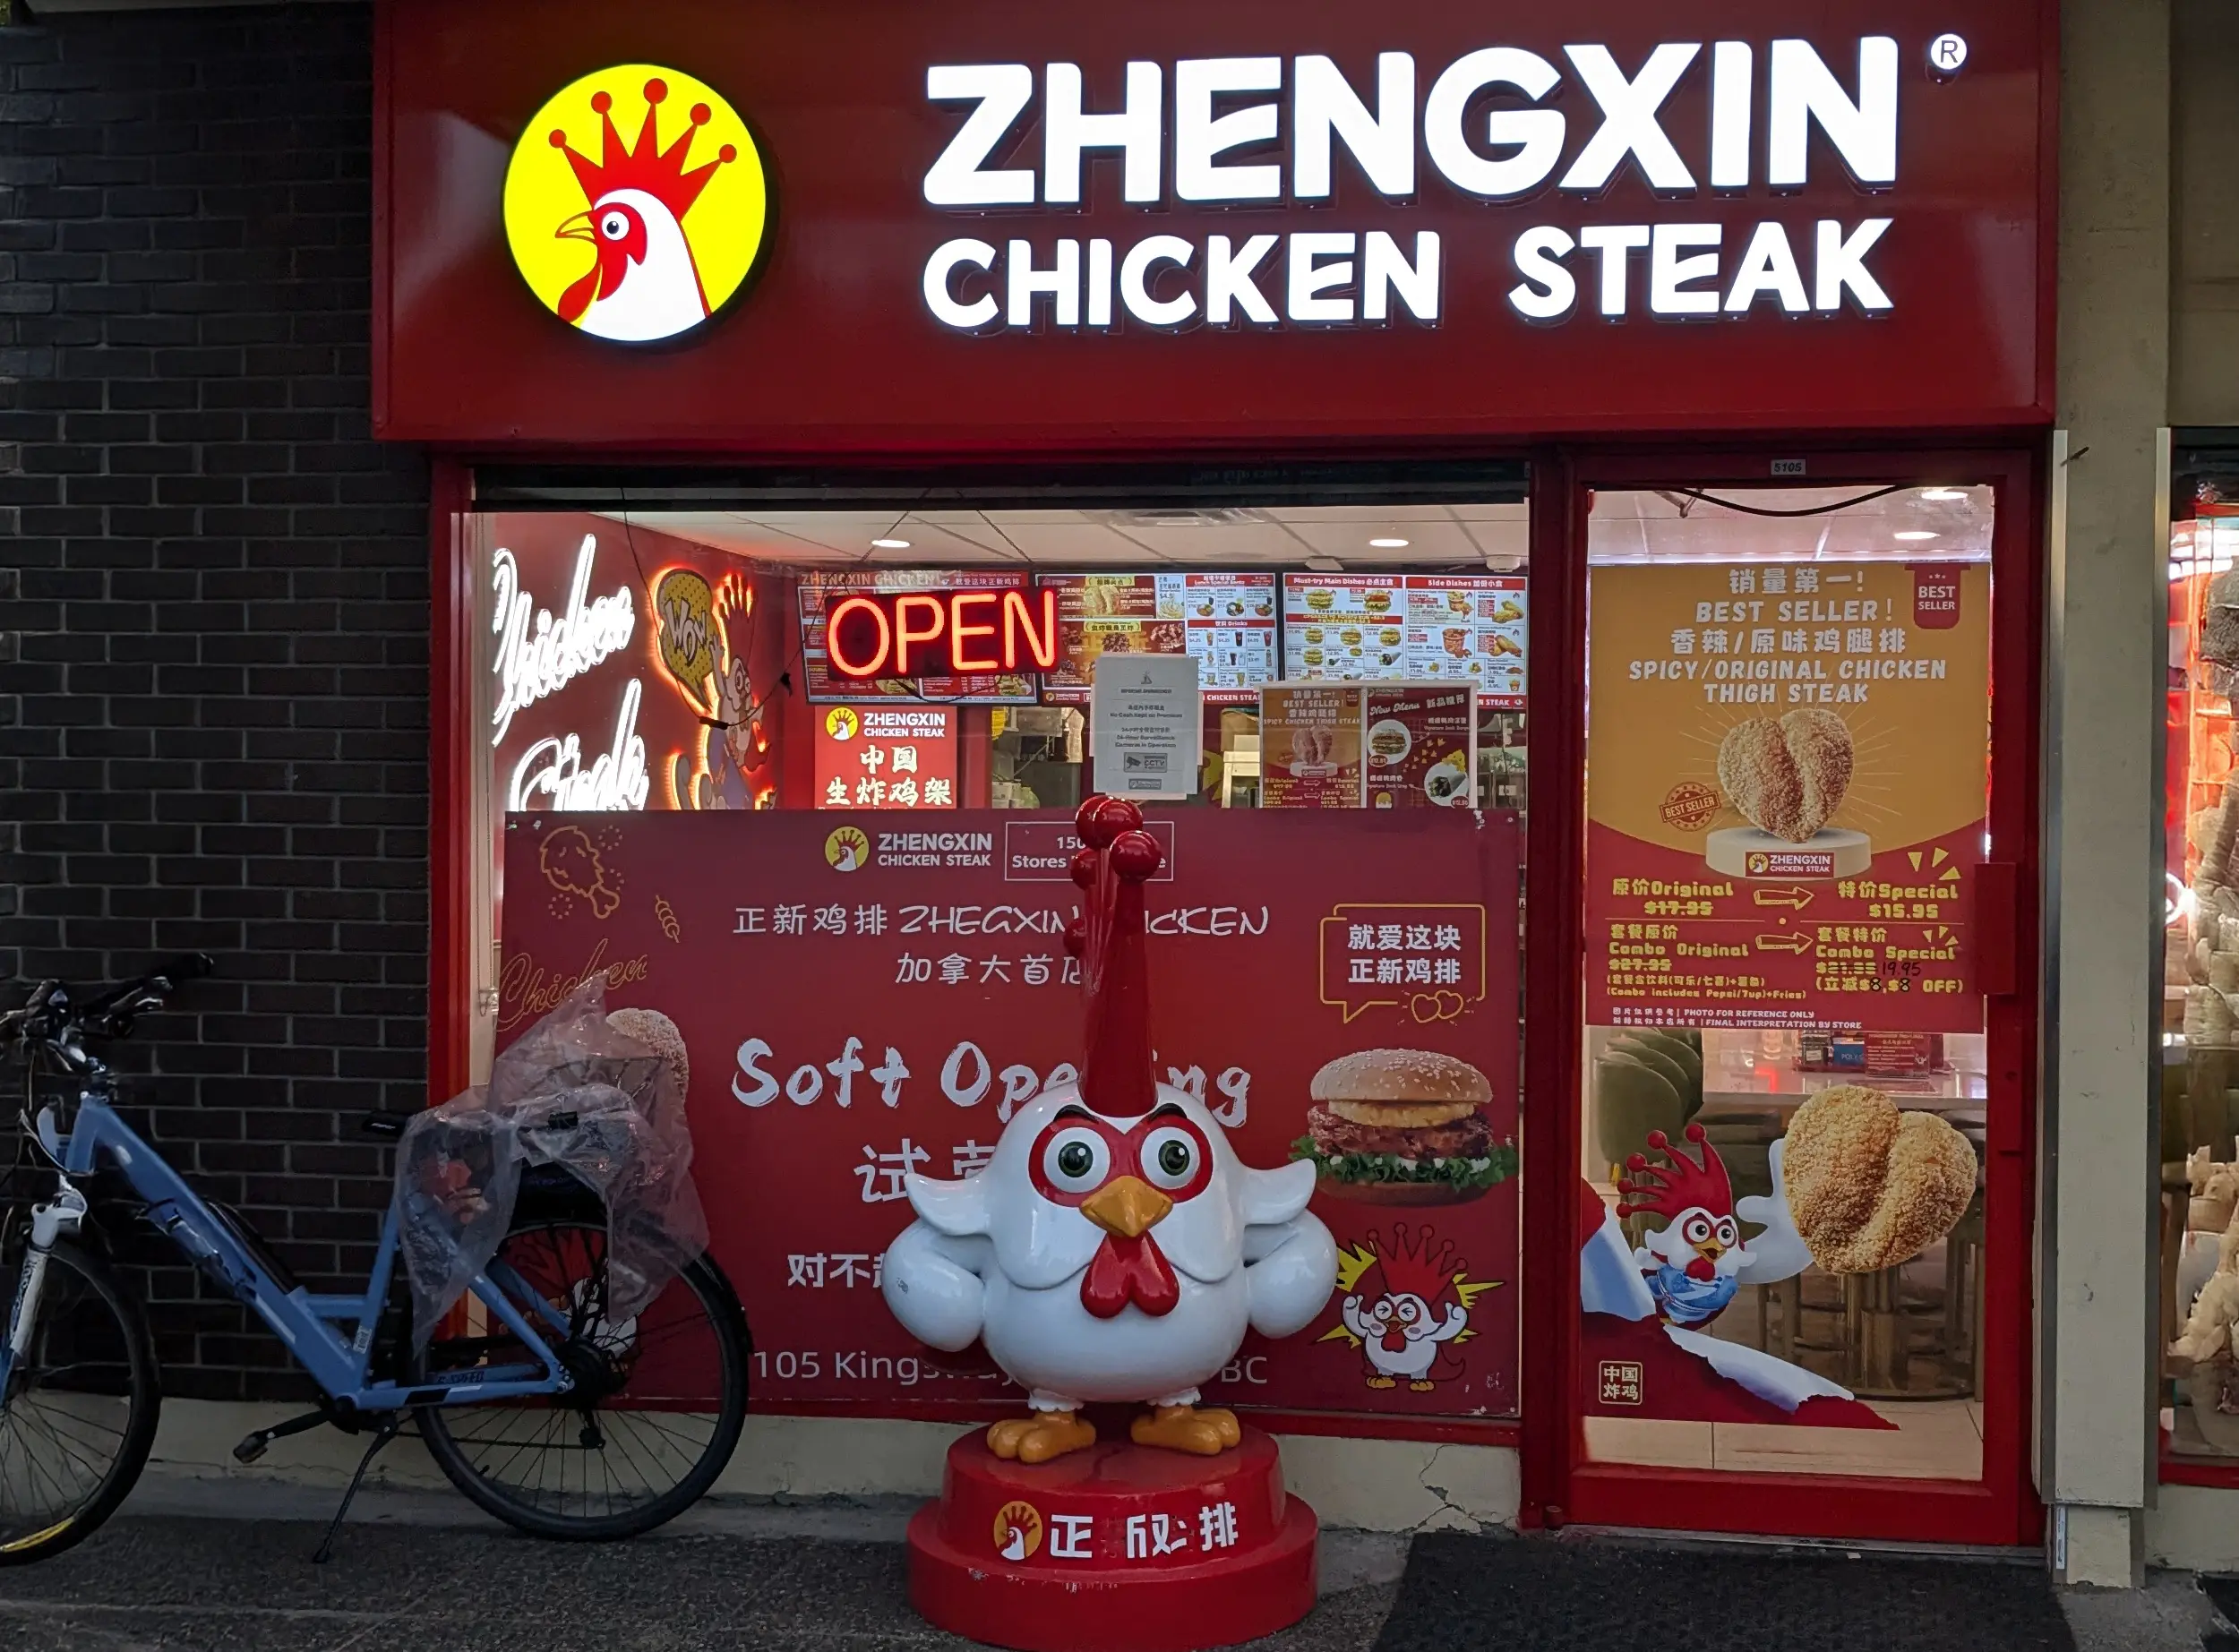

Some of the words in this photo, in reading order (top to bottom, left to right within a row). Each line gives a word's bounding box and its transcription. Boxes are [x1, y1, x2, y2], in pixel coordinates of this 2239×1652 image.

[922, 35, 1899, 205] ZHENGXIN
[922, 230, 1440, 328] CHICKEN
[1508, 218, 1894, 319] STEAK
[1772, 461, 1803, 473] 5105
[1728, 567, 1864, 595] 销量第一!
[1917, 586, 1956, 599] BEST
[1695, 601, 1764, 623] BEST
[1917, 601, 1956, 611] SELLER
[828, 590, 1055, 677] OPEN
[1669, 628, 1907, 655] 香辣/原味鸡腿排
[1629, 658, 1828, 680] SPICY/ORIGINAL
[1839, 659, 1946, 680] CHICKEN
[1703, 683, 1776, 703] THIGH
[1788, 683, 1869, 703] STEAK
[1486, 698, 1510, 706] STEAK
[863, 712, 946, 726] ZHENGXIN
[863, 727, 909, 737] CHICKEN
[912, 727, 945, 738] STEAK
[860, 744, 918, 775] 中国
[825, 775, 953, 807] 生炸鸡架
[1665, 803, 1686, 818] BEST
[1686, 796, 1715, 813] SELLER
[878, 834, 992, 852] ZHENGXIN
[878, 854, 941, 867] CHICKEN
[946, 853, 991, 867] STEAK
[1012, 855, 1067, 869] Stores
[1770, 854, 1832, 865] ZHENGXIN
[1644, 900, 1713, 915] $17.95
[1869, 903, 1939, 919] $15.95
[733, 903, 888, 936] 正新鸡排
[1144, 906, 1270, 937] ICKEN
[1347, 924, 1462, 951] 就爱这块
[1610, 924, 1678, 940] 套餐原价
[1817, 927, 1887, 943] 套餐特价
[1609, 942, 1666, 955] Combo
[1677, 943, 1749, 957] Original
[1815, 945, 1874, 958] Combo
[1885, 946, 1956, 961] Special
[1347, 958, 1462, 984] 正新鸡排
[1883, 962, 1922, 976] 19.95
[1607, 987, 1646, 997] (Combo
[1651, 988, 1700, 997] includes
[1922, 980, 1964, 994] OFF)
[1684, 1009, 1714, 1017] PHOTO
[1736, 1010, 1788, 1018] REFERENCE
[1789, 1011, 1814, 1019] ONLY
[1705, 1018, 1735, 1026] FINAL
[1736, 1020, 1816, 1029] INTERPRETATION
[1818, 1021, 1831, 1029] BY
[731, 1036, 912, 1109] Soft
[940, 1040, 1253, 1128] Openg
[835, 1349, 1014, 1386] Kings
[1602, 1365, 1638, 1382] 中国
[1602, 1382, 1639, 1400] 炸鸡
